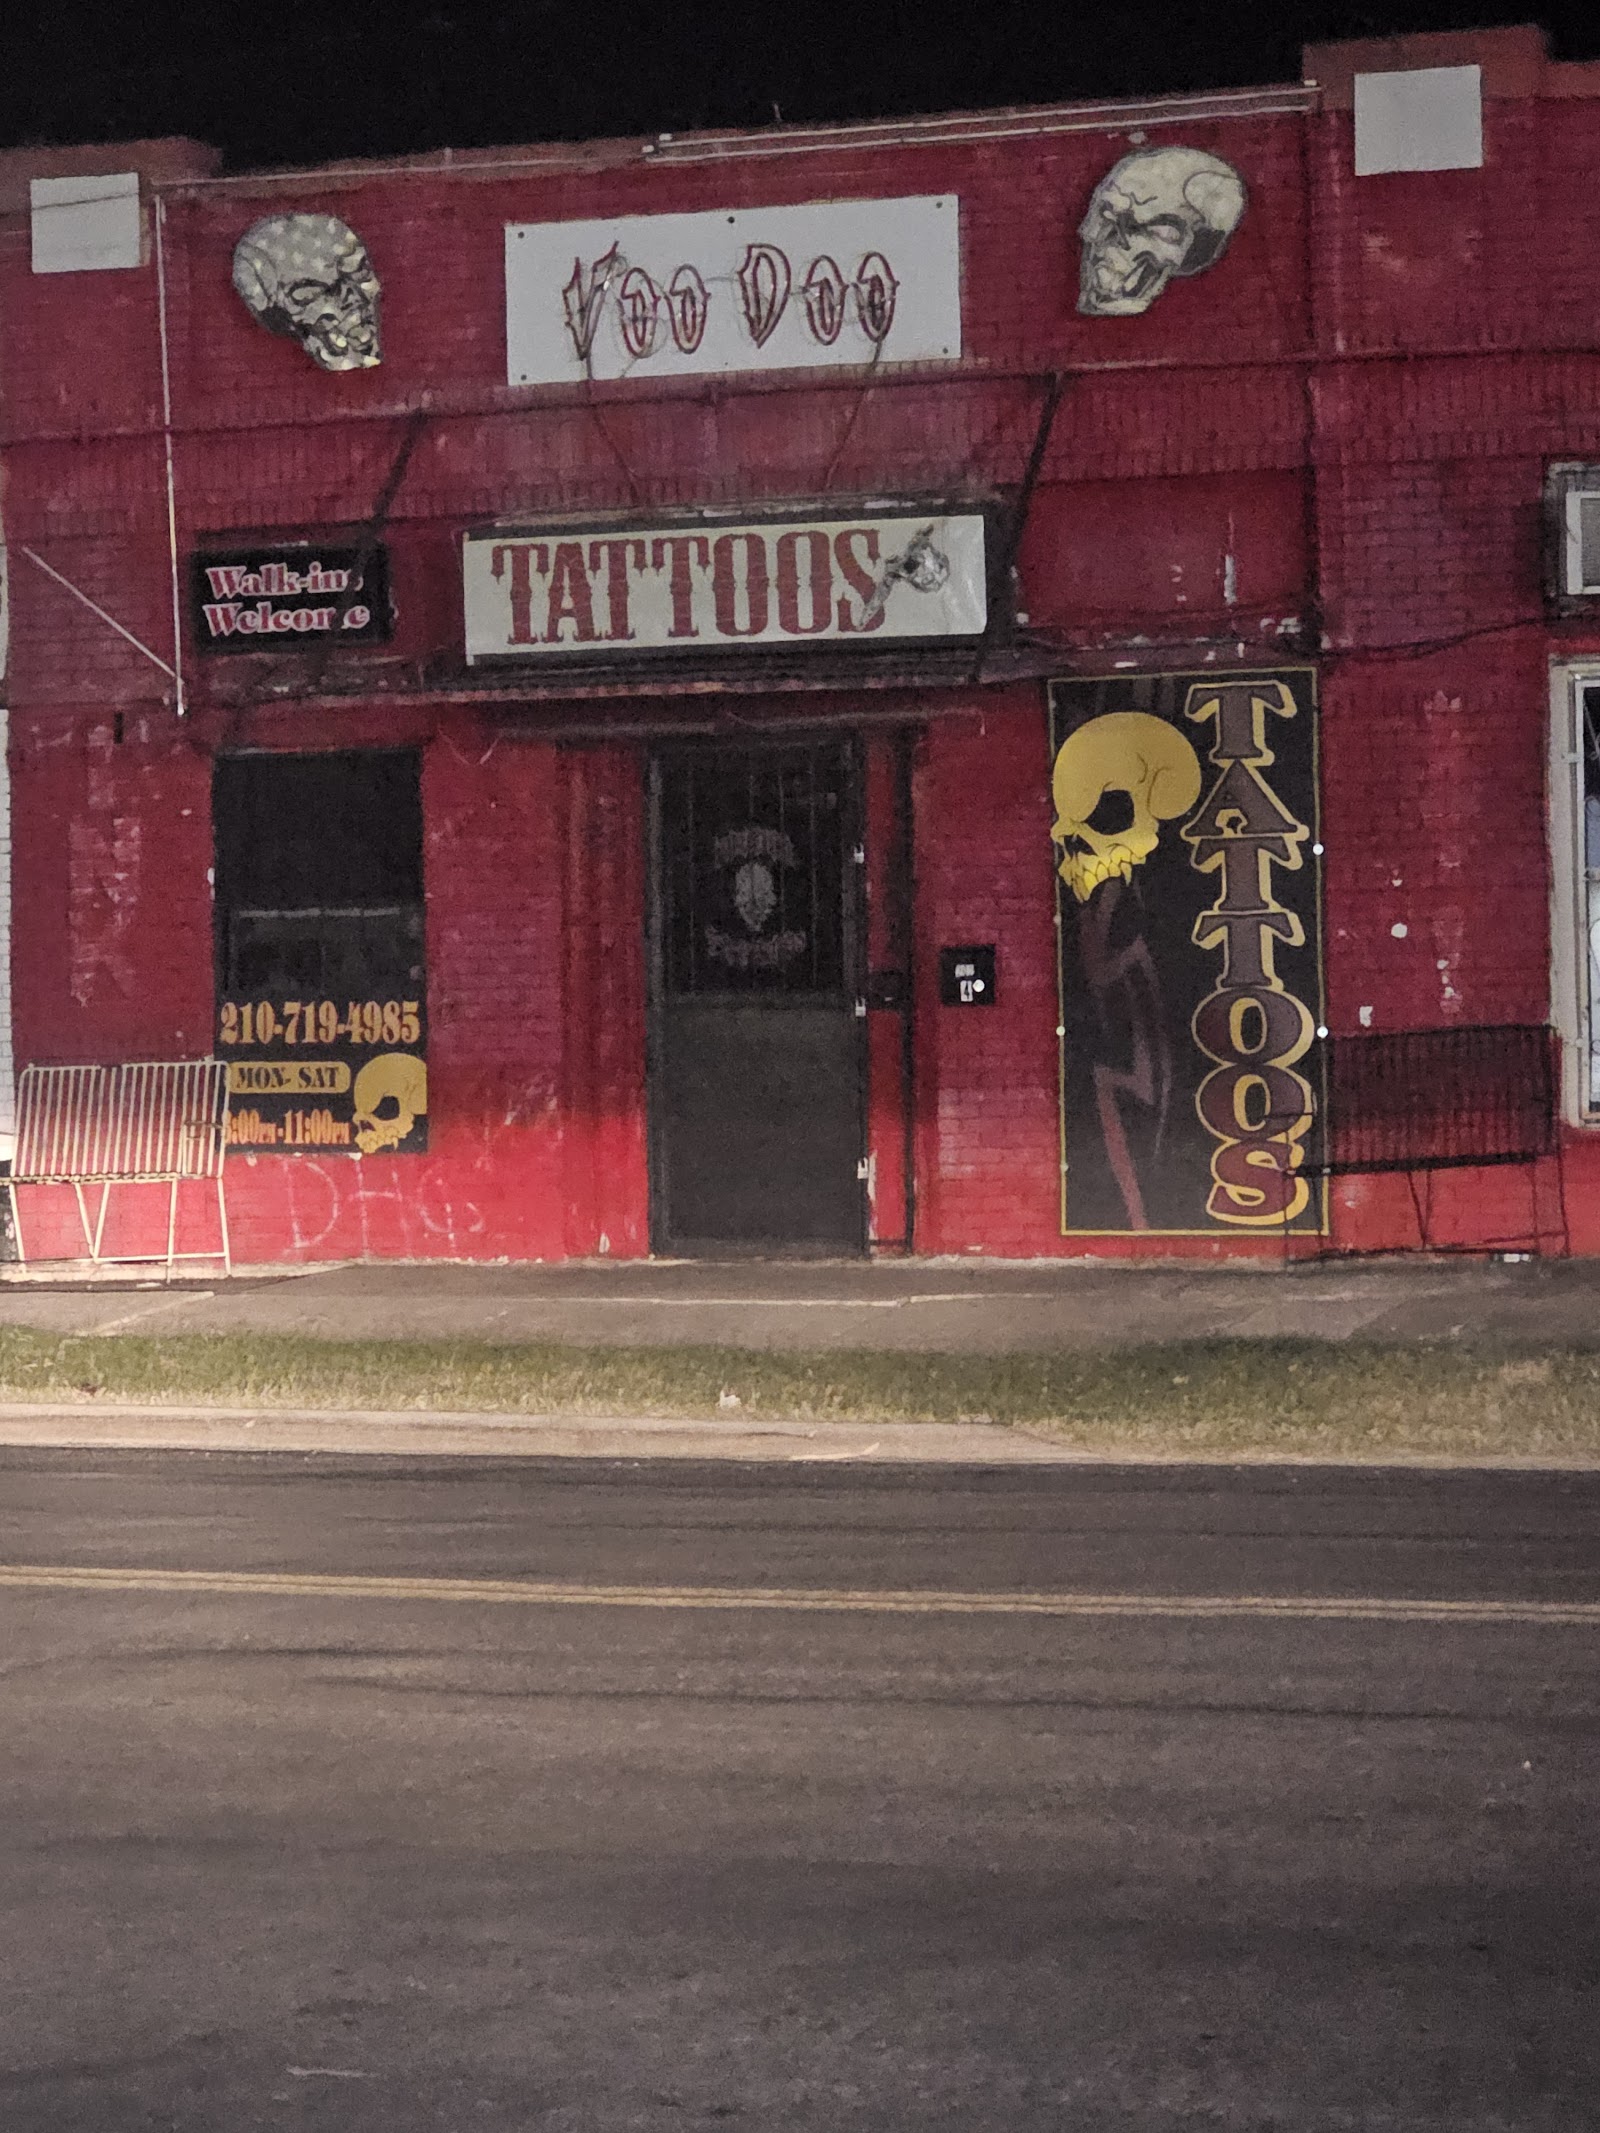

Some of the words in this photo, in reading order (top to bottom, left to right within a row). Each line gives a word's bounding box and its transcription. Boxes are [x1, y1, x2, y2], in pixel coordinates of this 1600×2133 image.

[491, 528, 886, 646] TATTOOS
[1181, 680, 1316, 1225] TATTOOS
[220, 1000, 421, 1045] 210-719-4985
[298, 1066, 340, 1088] SAT
